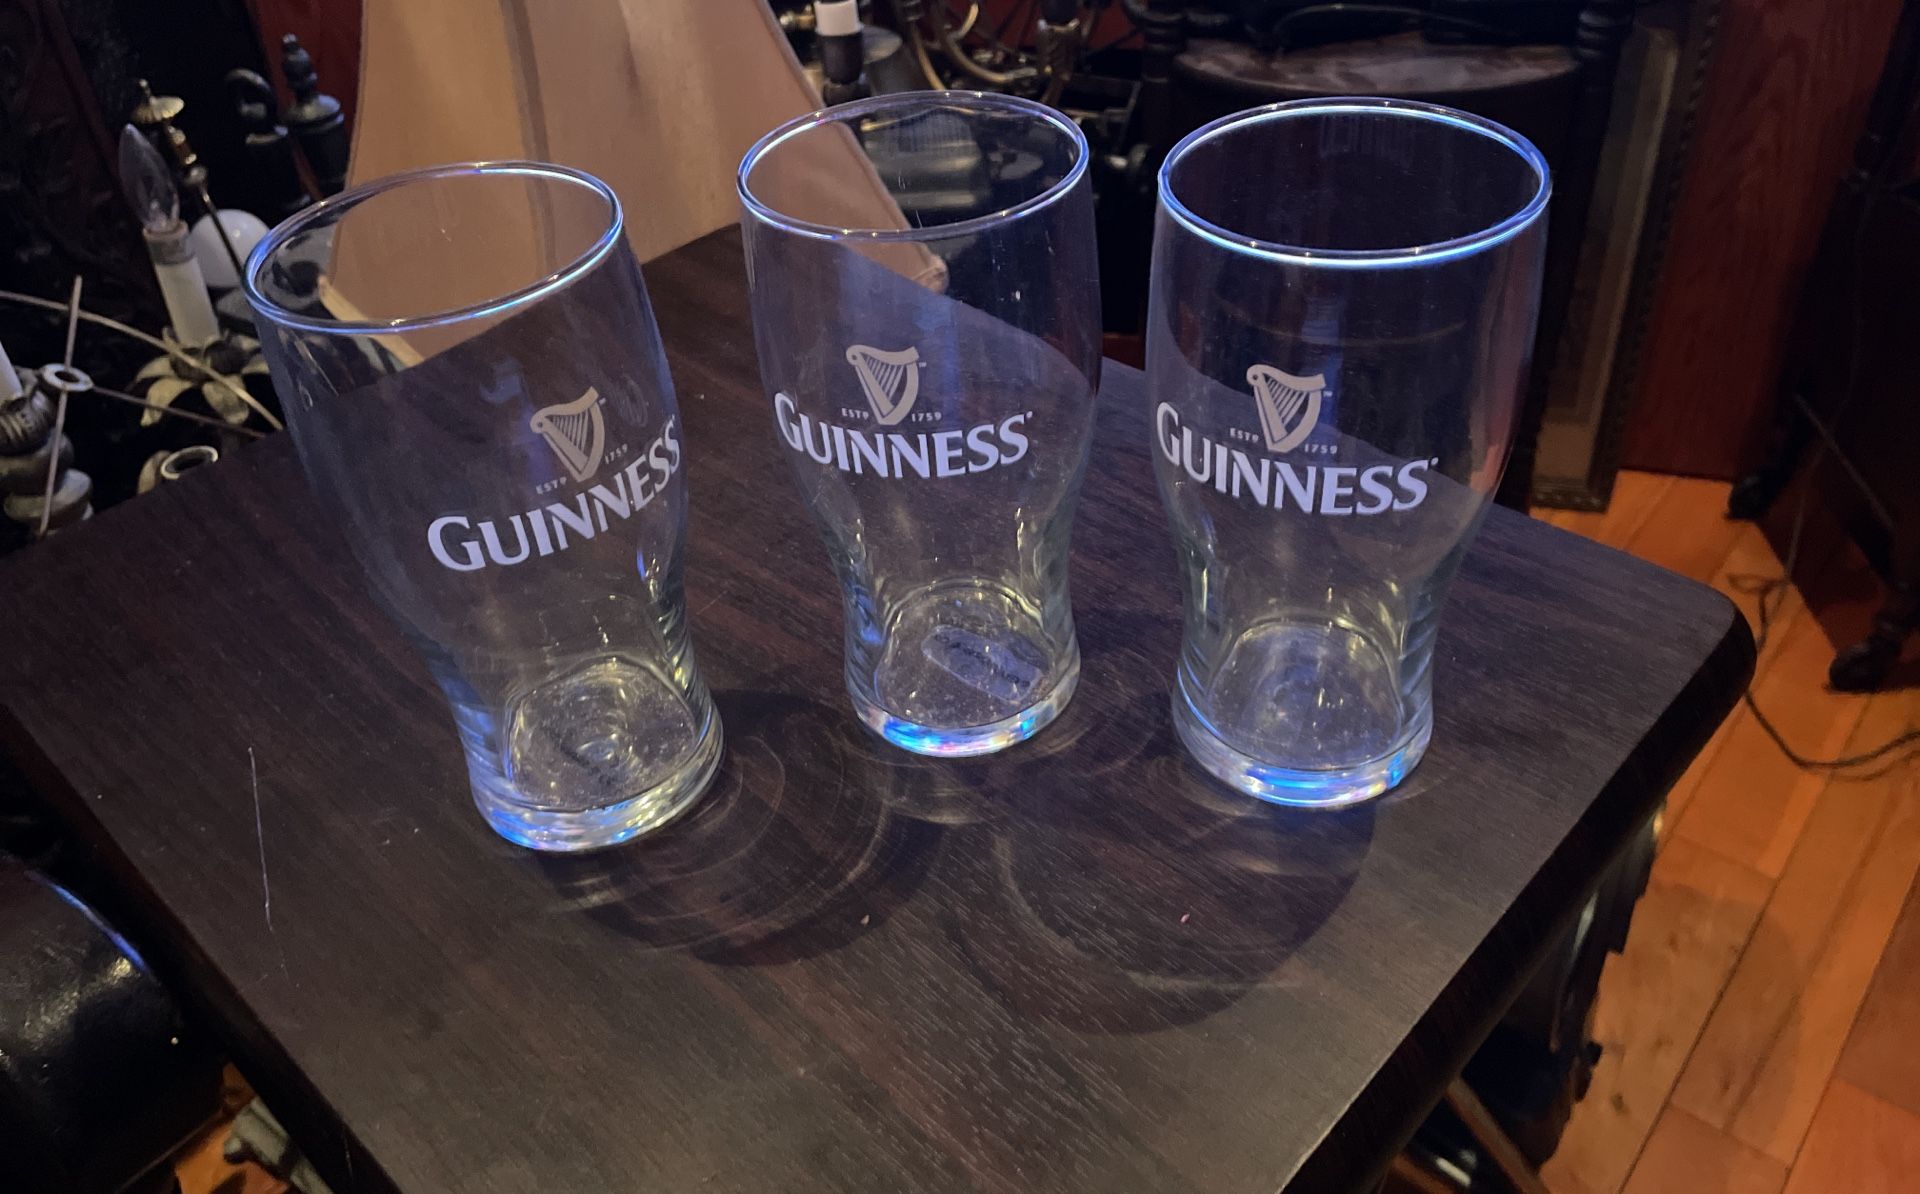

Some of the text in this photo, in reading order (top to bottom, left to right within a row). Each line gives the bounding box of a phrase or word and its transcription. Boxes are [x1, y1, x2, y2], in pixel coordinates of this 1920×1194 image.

[775, 391, 1030, 478] GUINNESS
[911, 411, 942, 422] 1759
[1157, 402, 1430, 515] GUINNESS
[1304, 443, 1338, 454] 1759
[427, 417, 680, 571] GUINNESS
